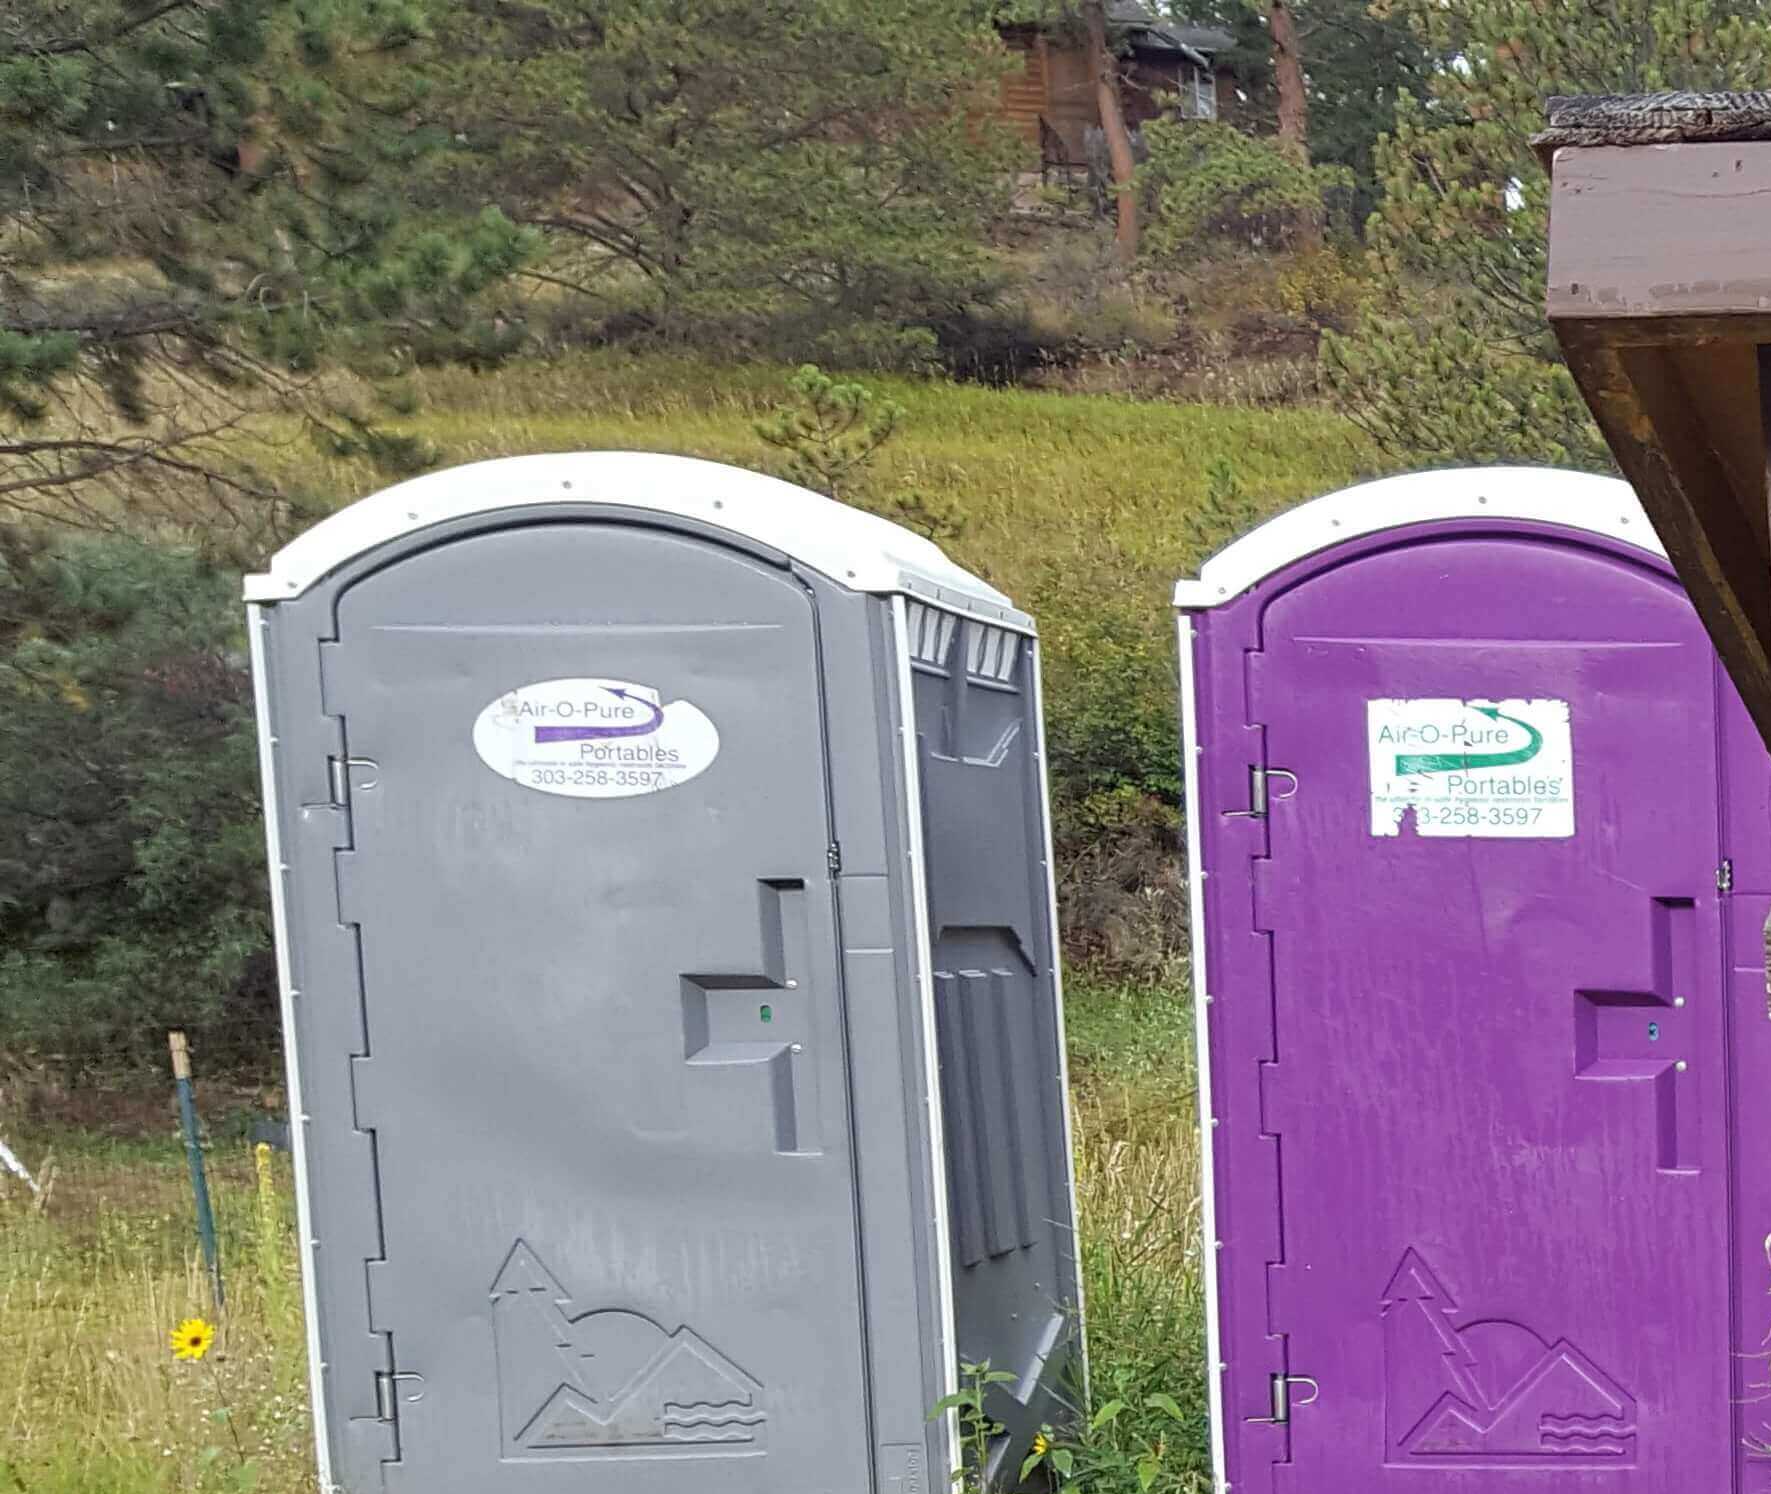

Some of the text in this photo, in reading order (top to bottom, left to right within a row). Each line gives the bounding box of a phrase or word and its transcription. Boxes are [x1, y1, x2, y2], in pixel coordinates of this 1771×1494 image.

[518, 701, 635, 719] Air-O-Pure
[1378, 724, 1509, 744] Air-O-Pure
[580, 743, 679, 762] Portables
[531, 769, 663, 786] 303-258-3597
[1448, 775, 1561, 796] Portables
[1393, 806, 1543, 825] 33-258-3597
